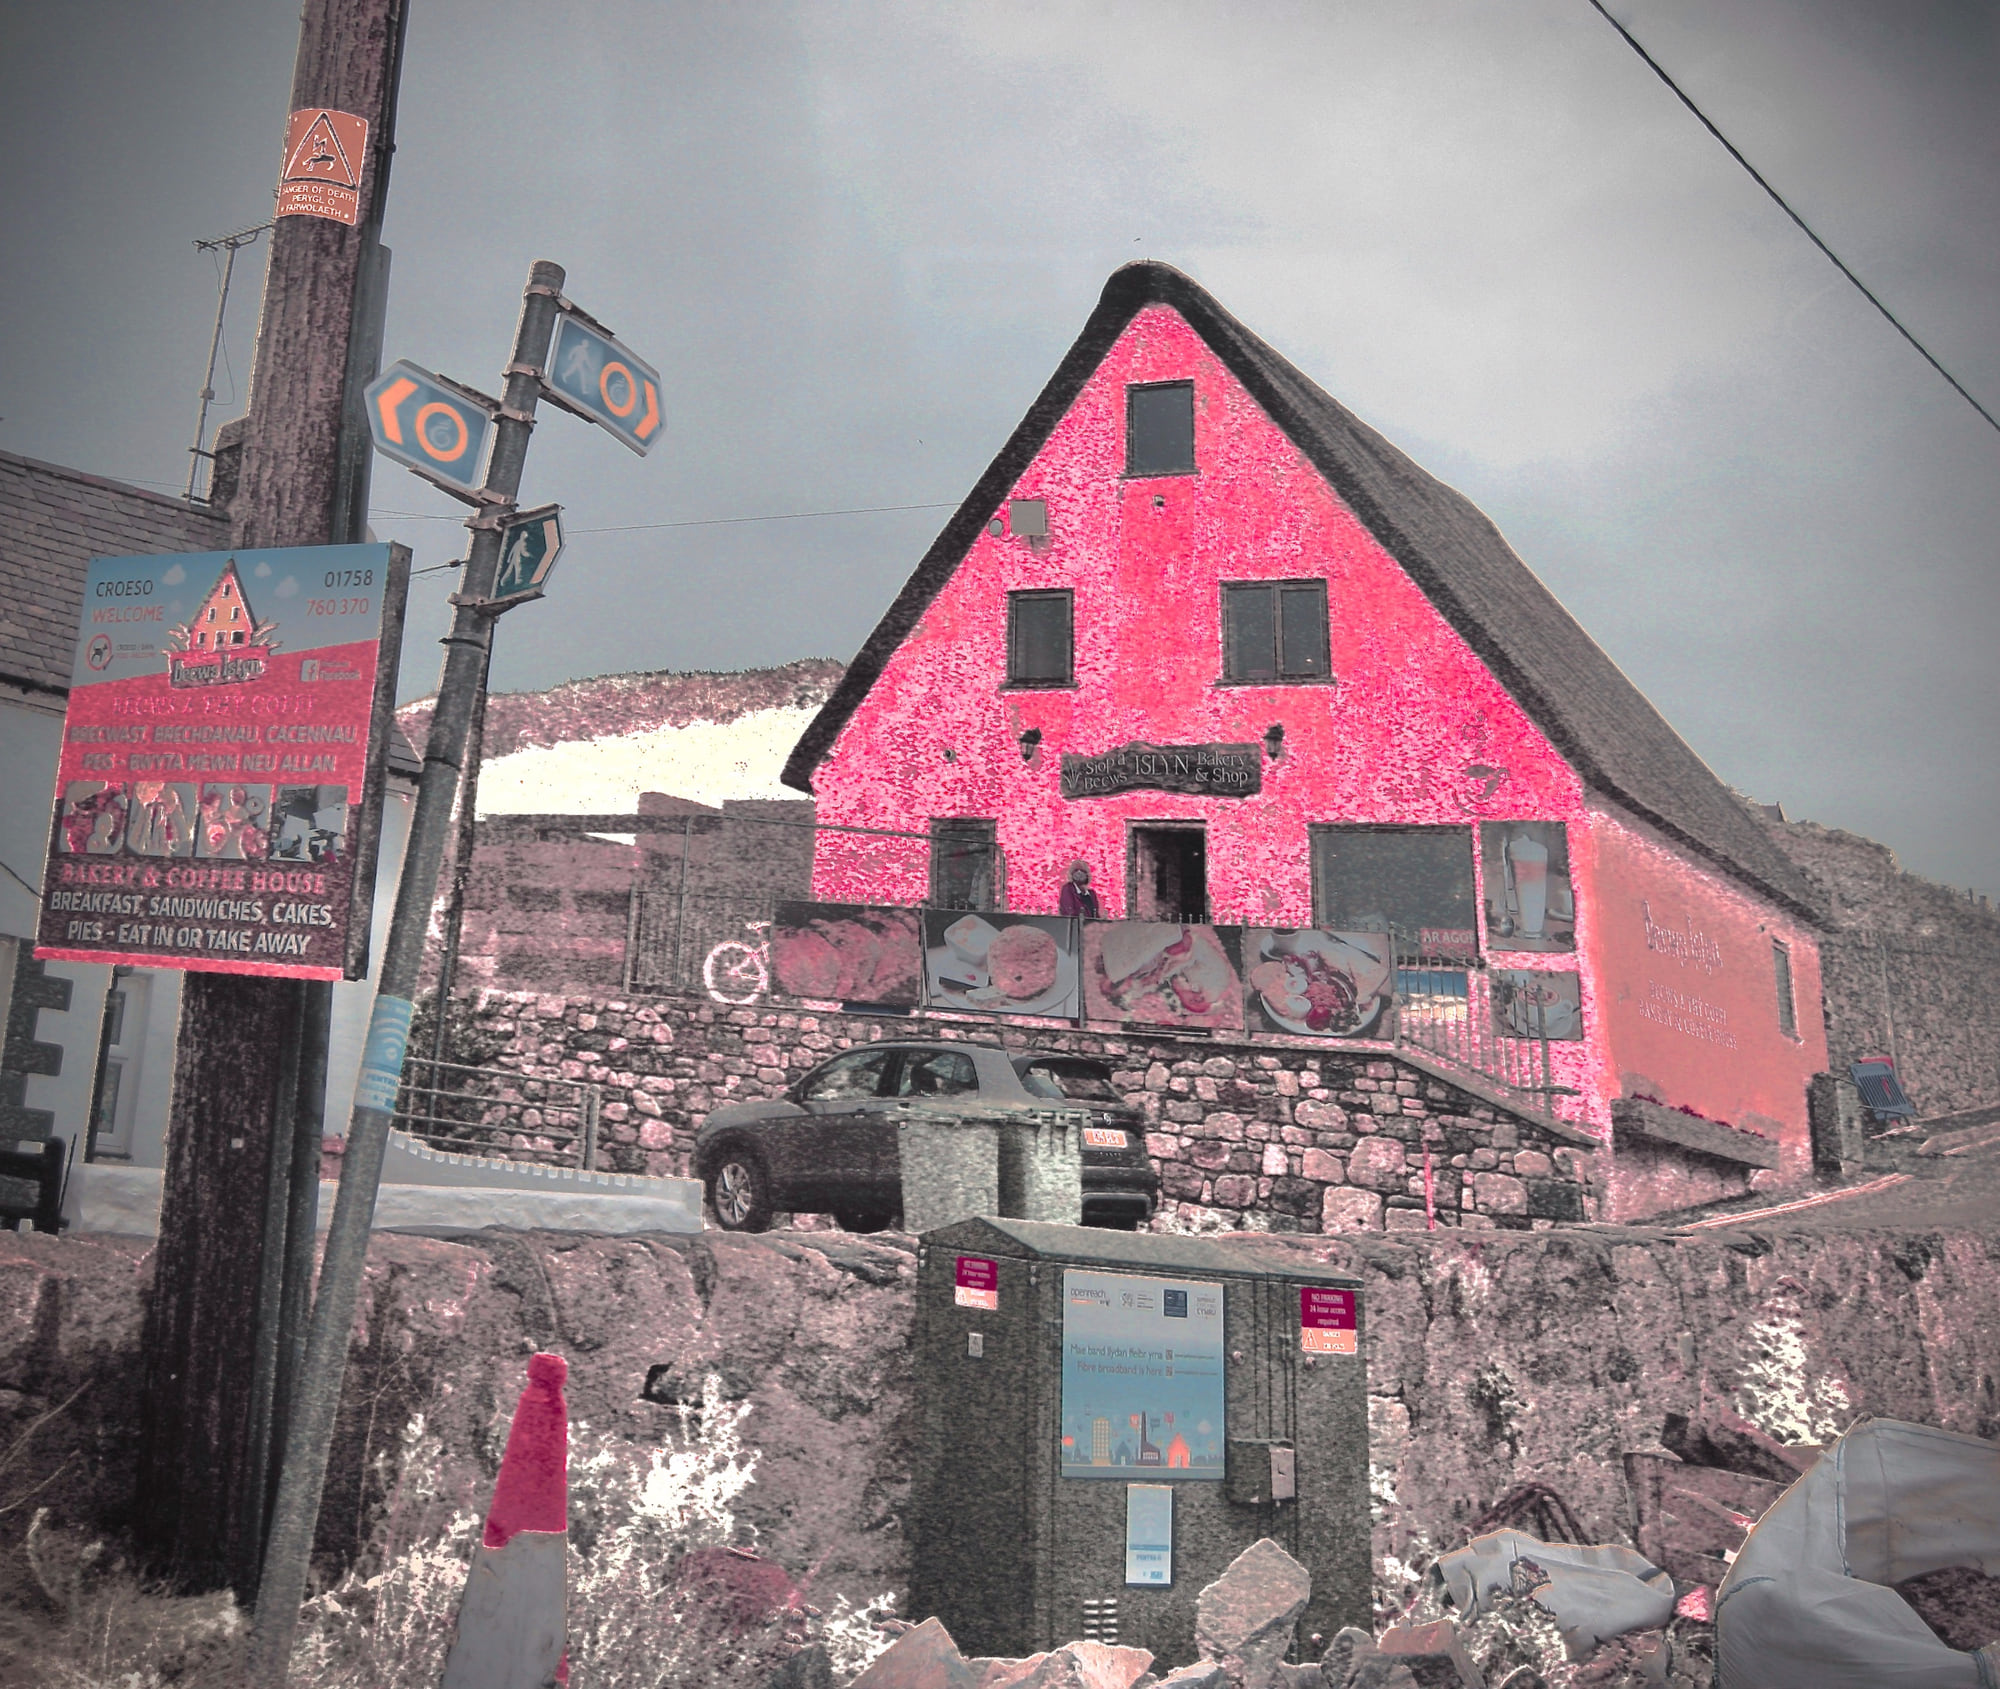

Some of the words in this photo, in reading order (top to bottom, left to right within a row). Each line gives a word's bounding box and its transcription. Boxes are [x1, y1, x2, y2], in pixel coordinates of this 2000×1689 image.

[292, 194, 325, 204] PERYGL
[327, 198, 336, 206] O
[311, 186, 325, 194] OF
[328, 188, 355, 203] DEATH
[285, 203, 342, 218] FARWOLAETH
[324, 569, 374, 588] 01758
[96, 579, 154, 598] CROESO
[92, 605, 165, 624] WELCOME
[306, 599, 336, 617] 760
[339, 597, 370, 615] 370
[129, 753, 183, 771] BWYTA
[187, 754, 237, 772] MEWN
[242, 754, 275, 772] NEU
[279, 754, 336, 773] ALLAN
[1085, 757, 1115, 775] Siop
[1134, 754, 1190, 777] ISLYN
[1197, 751, 1247, 768] Bakery
[1195, 768, 1209, 783] &
[1212, 767, 1249, 788] Shop
[62, 863, 138, 885] BAKERY
[143, 865, 160, 888] &
[166, 866, 246, 891] COFFEE
[250, 871, 326, 895] HOUSE
[50, 891, 145, 918] BREAKFAST,
[148, 895, 267, 925] SANDWICHES,
[272, 902, 337, 929] CAKES,
[67, 920, 104, 941] PIES
[117, 923, 152, 945] EAT
[153, 926, 176, 947] IN
[176, 927, 203, 949] OR
[206, 929, 253, 952] TAKE
[253, 932, 312, 955] AWAY
